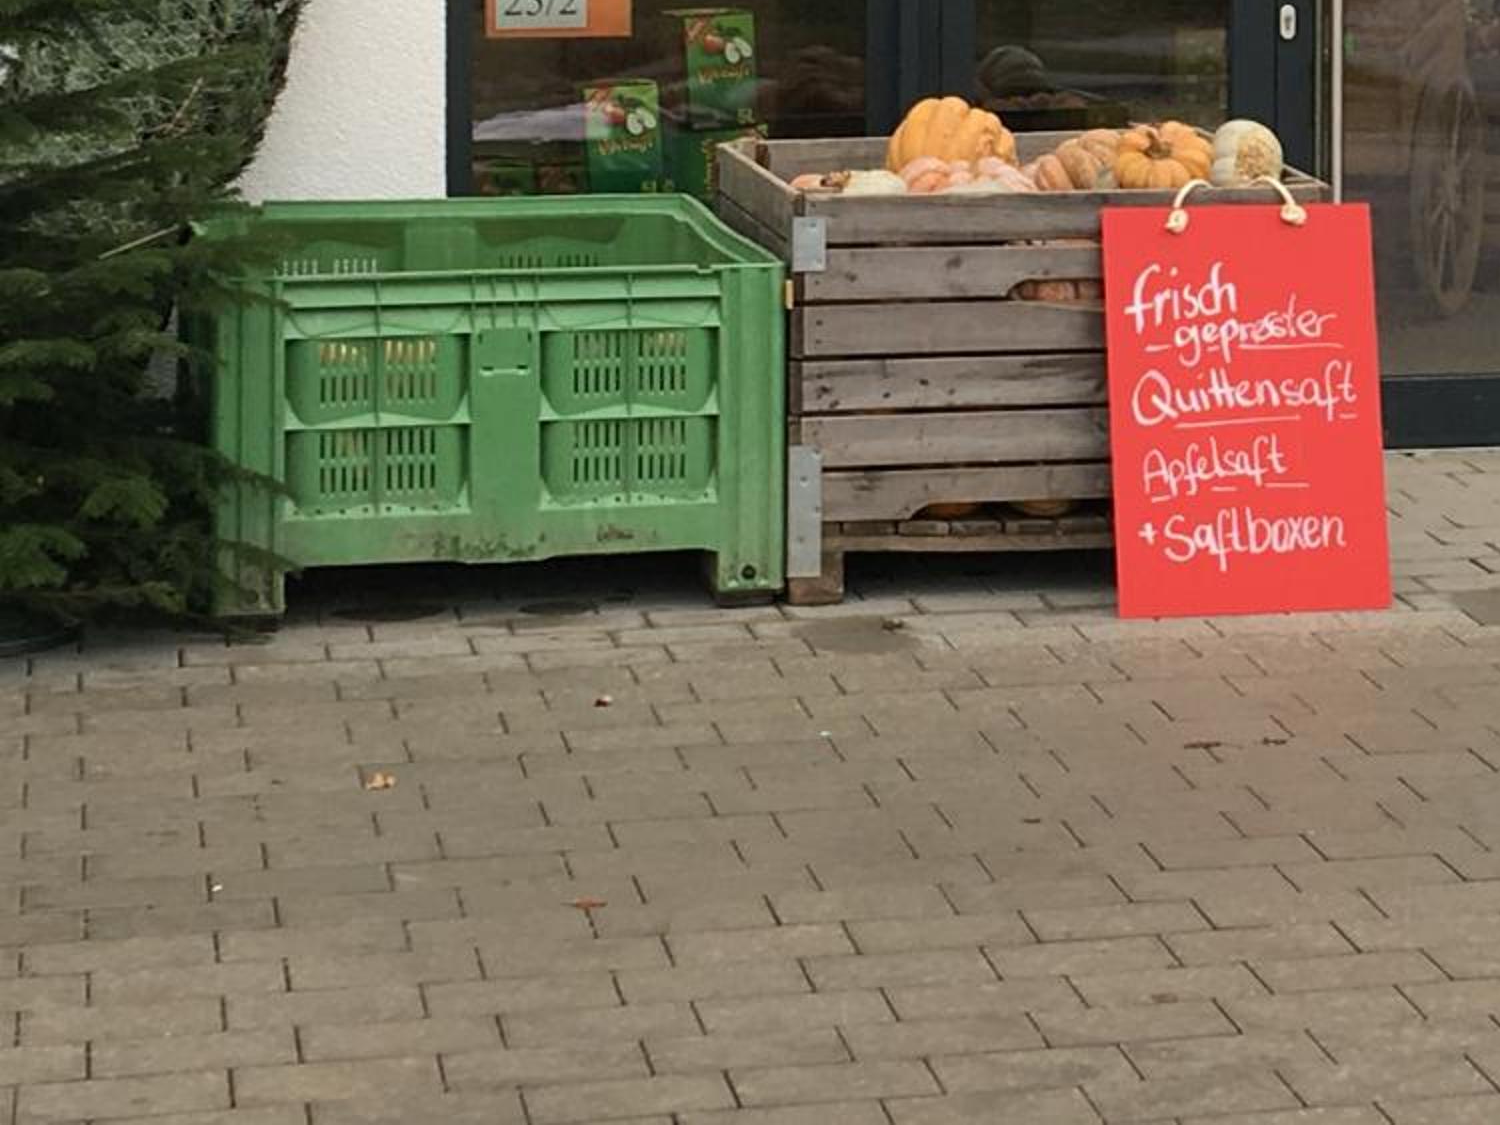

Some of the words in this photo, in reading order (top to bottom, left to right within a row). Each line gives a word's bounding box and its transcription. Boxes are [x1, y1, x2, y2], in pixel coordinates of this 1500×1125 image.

[1124, 261, 1238, 334] frisch
[1131, 359, 1358, 427] Quittensaft
[1142, 432, 1288, 498] Apfelsaft
